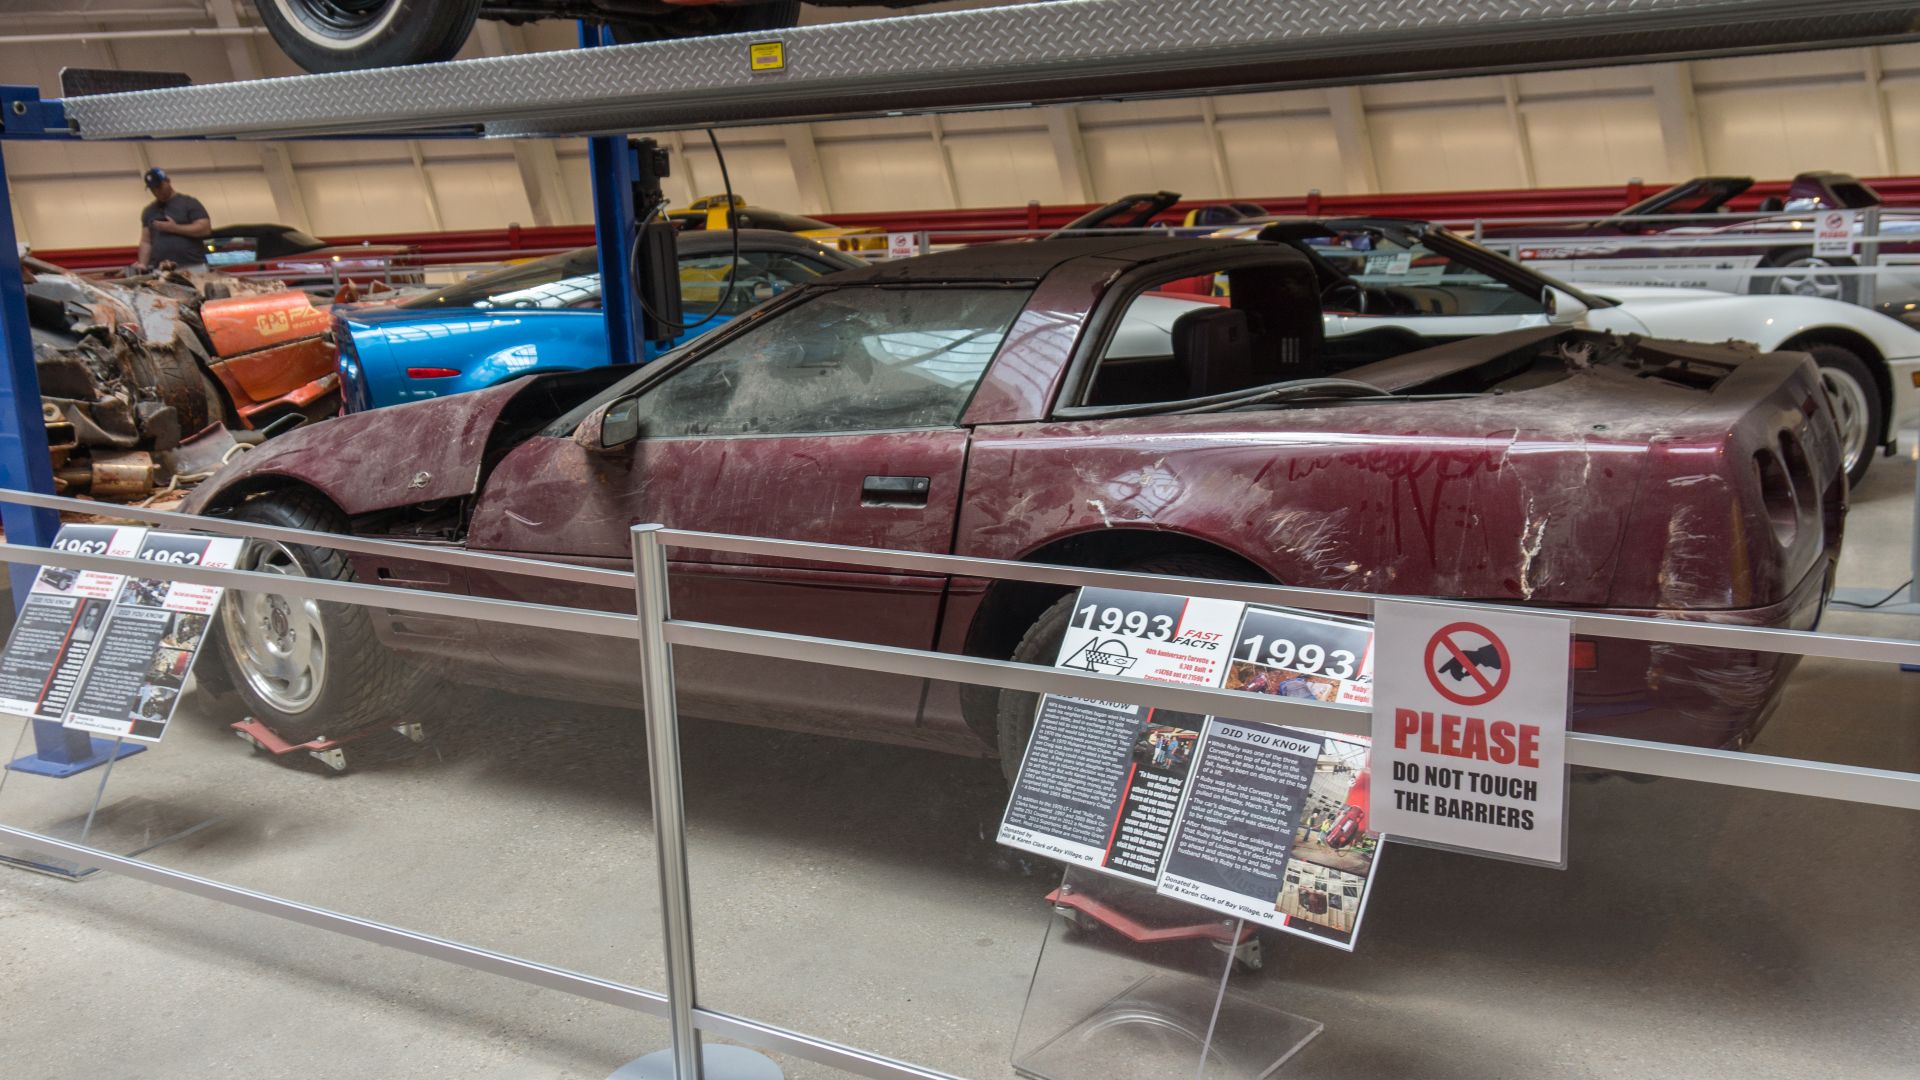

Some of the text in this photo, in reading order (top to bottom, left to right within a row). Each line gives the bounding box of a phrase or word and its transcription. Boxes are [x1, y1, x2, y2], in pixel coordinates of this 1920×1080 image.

[55, 538, 107, 554] 1962
[141, 549, 200, 565] 1962
[1079, 604, 1174, 641] 1993
[1173, 636, 1220, 650] FACTS
[1184, 629, 1224, 641] FAST
[1243, 634, 1355, 679] 1993
[1221, 728, 1310, 753] DID YOU KNOW
[1394, 707, 1540, 769] PLEASE
[1393, 760, 1537, 802] DO NOT TOUCH
[1394, 789, 1534, 831] THE BARRIERS
[1165, 876, 1192, 887] Donated
[1181, 888, 1199, 897] Karen
[1200, 894, 1217, 902] Clark
[1225, 901, 1238, 909] Bay
